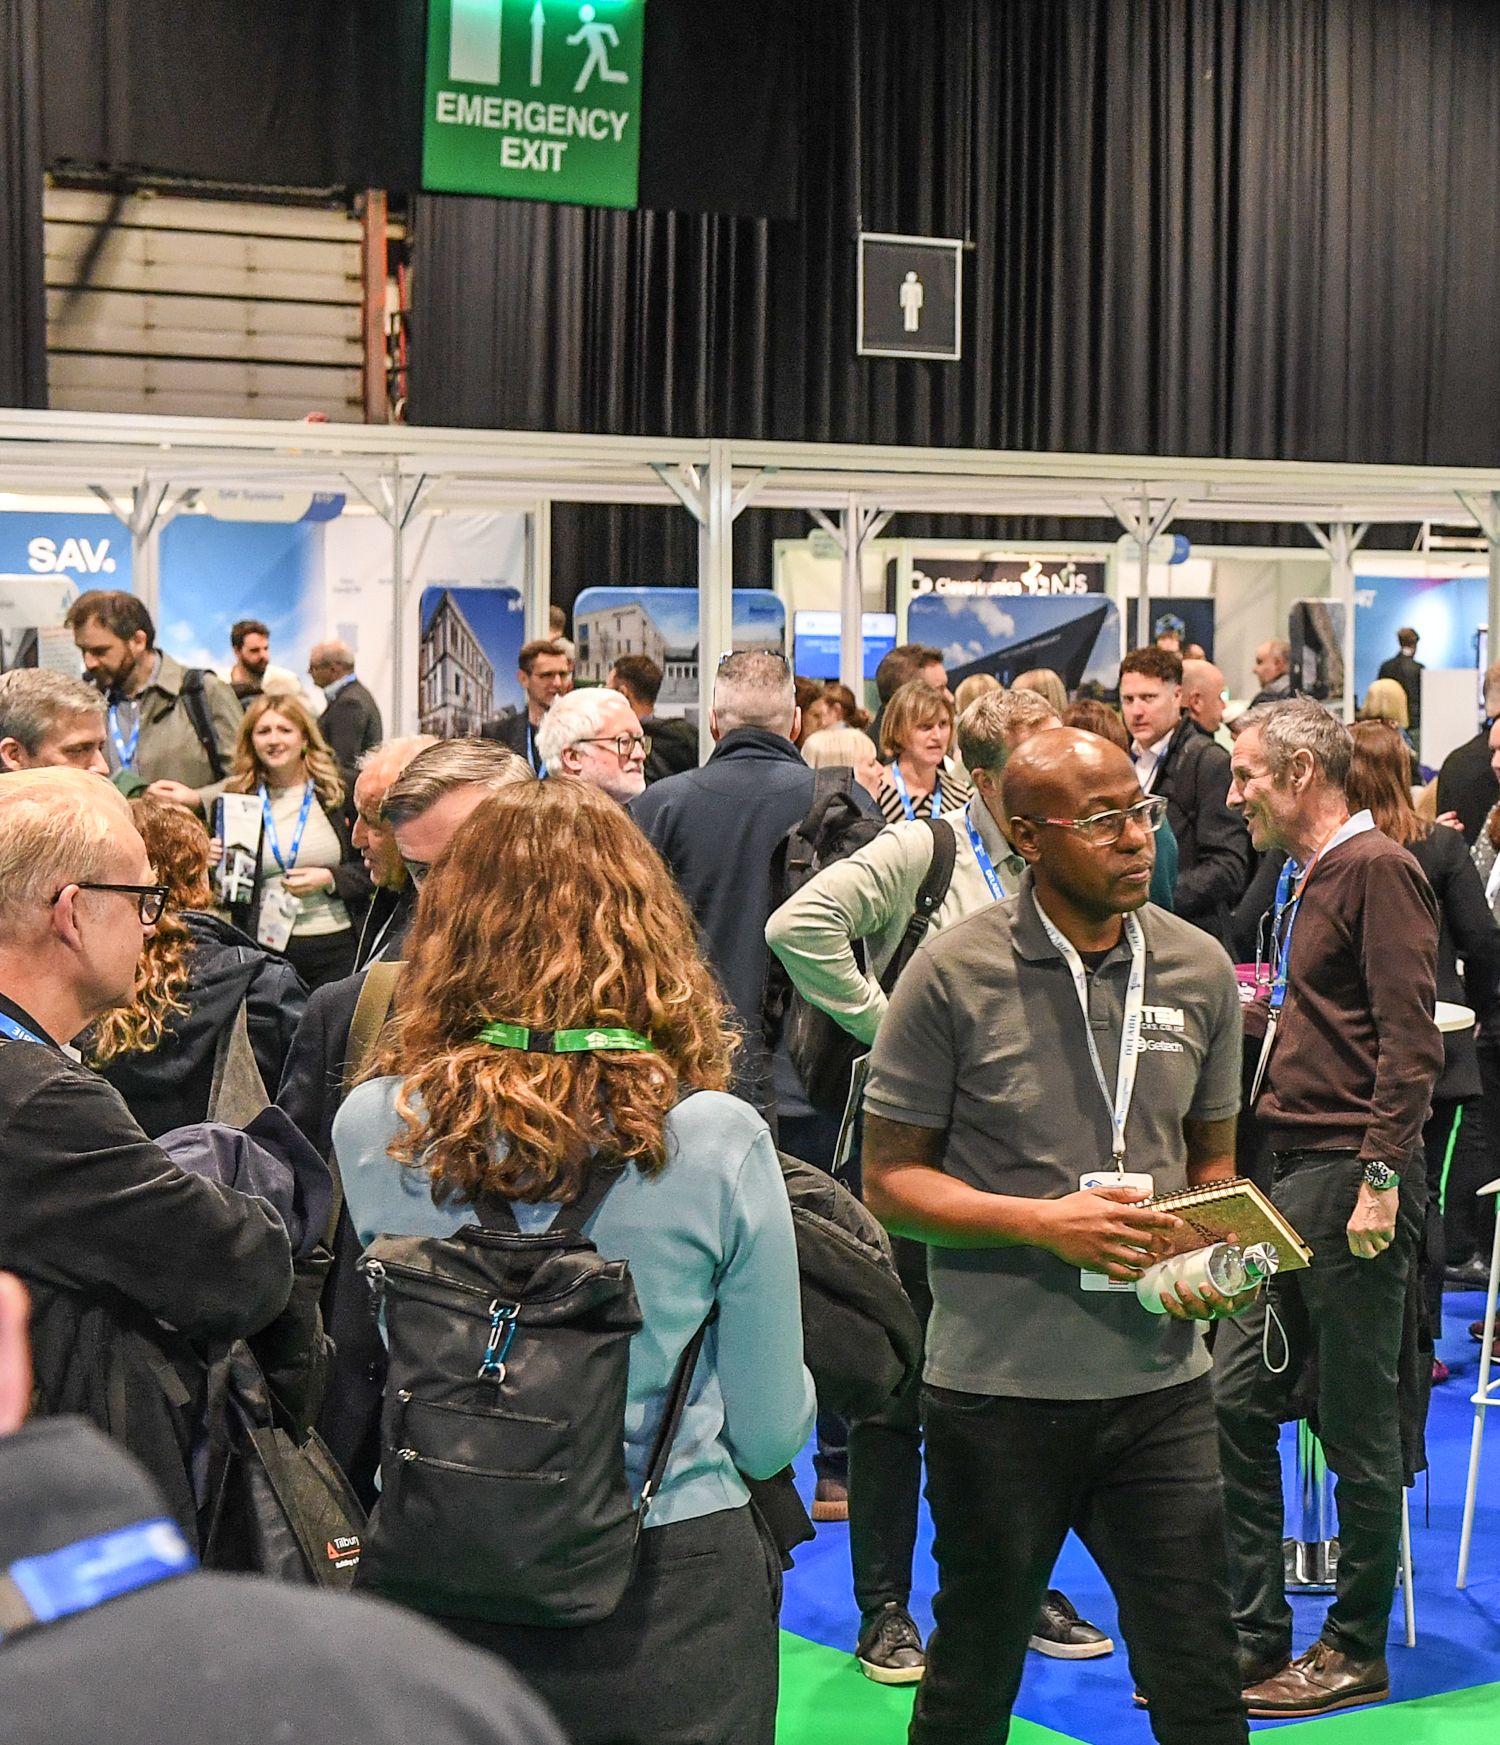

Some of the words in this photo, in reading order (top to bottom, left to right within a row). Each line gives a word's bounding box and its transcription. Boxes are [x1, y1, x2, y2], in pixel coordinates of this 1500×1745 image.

[436, 91, 629, 142] EMERGENCY
[500, 136, 568, 172] EXIT
[28, 537, 116, 573] SAV.
